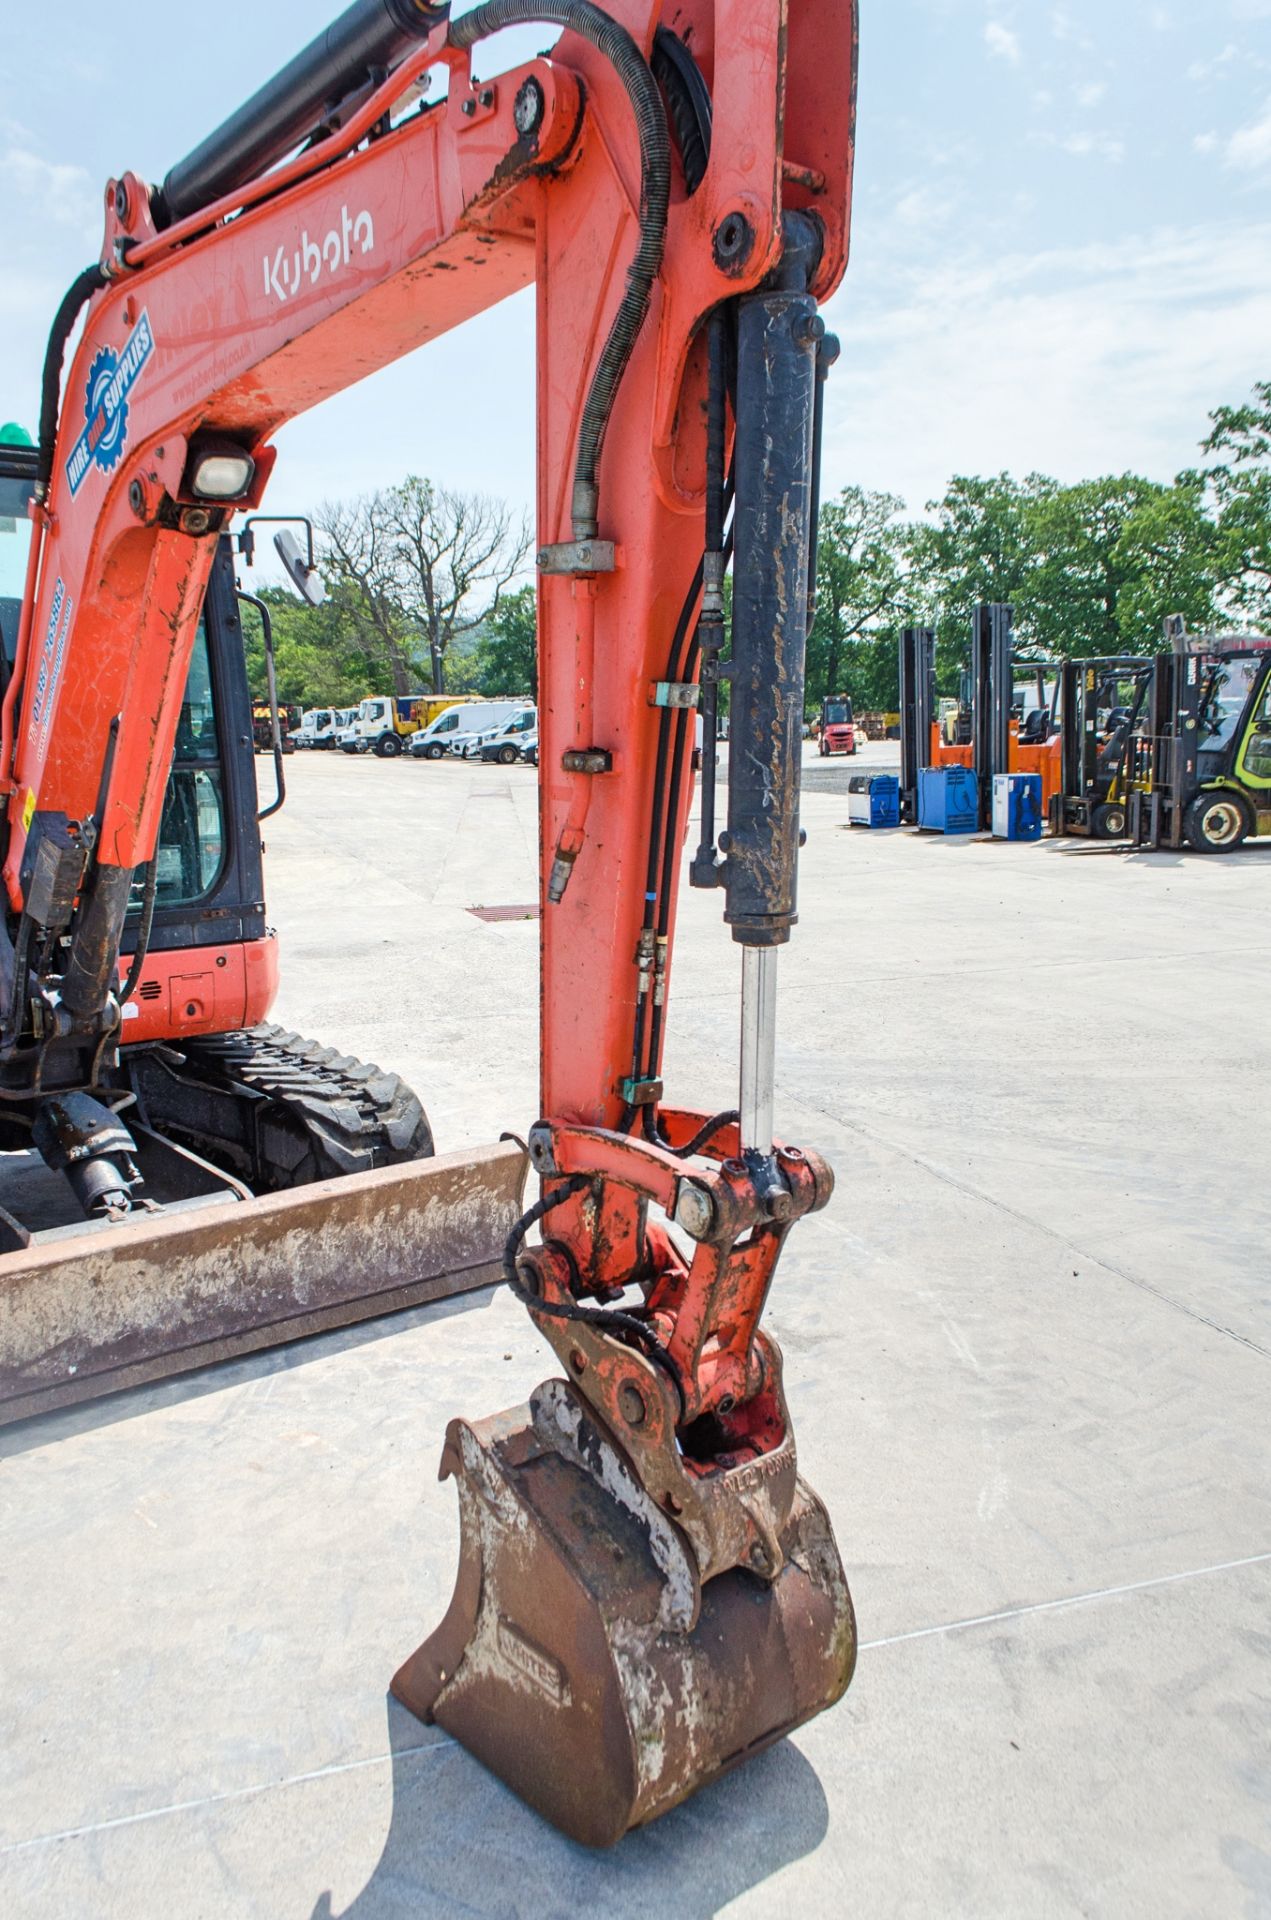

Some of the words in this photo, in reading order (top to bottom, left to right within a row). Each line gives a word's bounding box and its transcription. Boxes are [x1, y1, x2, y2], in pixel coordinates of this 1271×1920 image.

[263, 204, 374, 302] Kubota
[67, 438, 91, 489] HIRE
[103, 321, 151, 419] SUPPLIES
[45, 576, 65, 660] 265882
